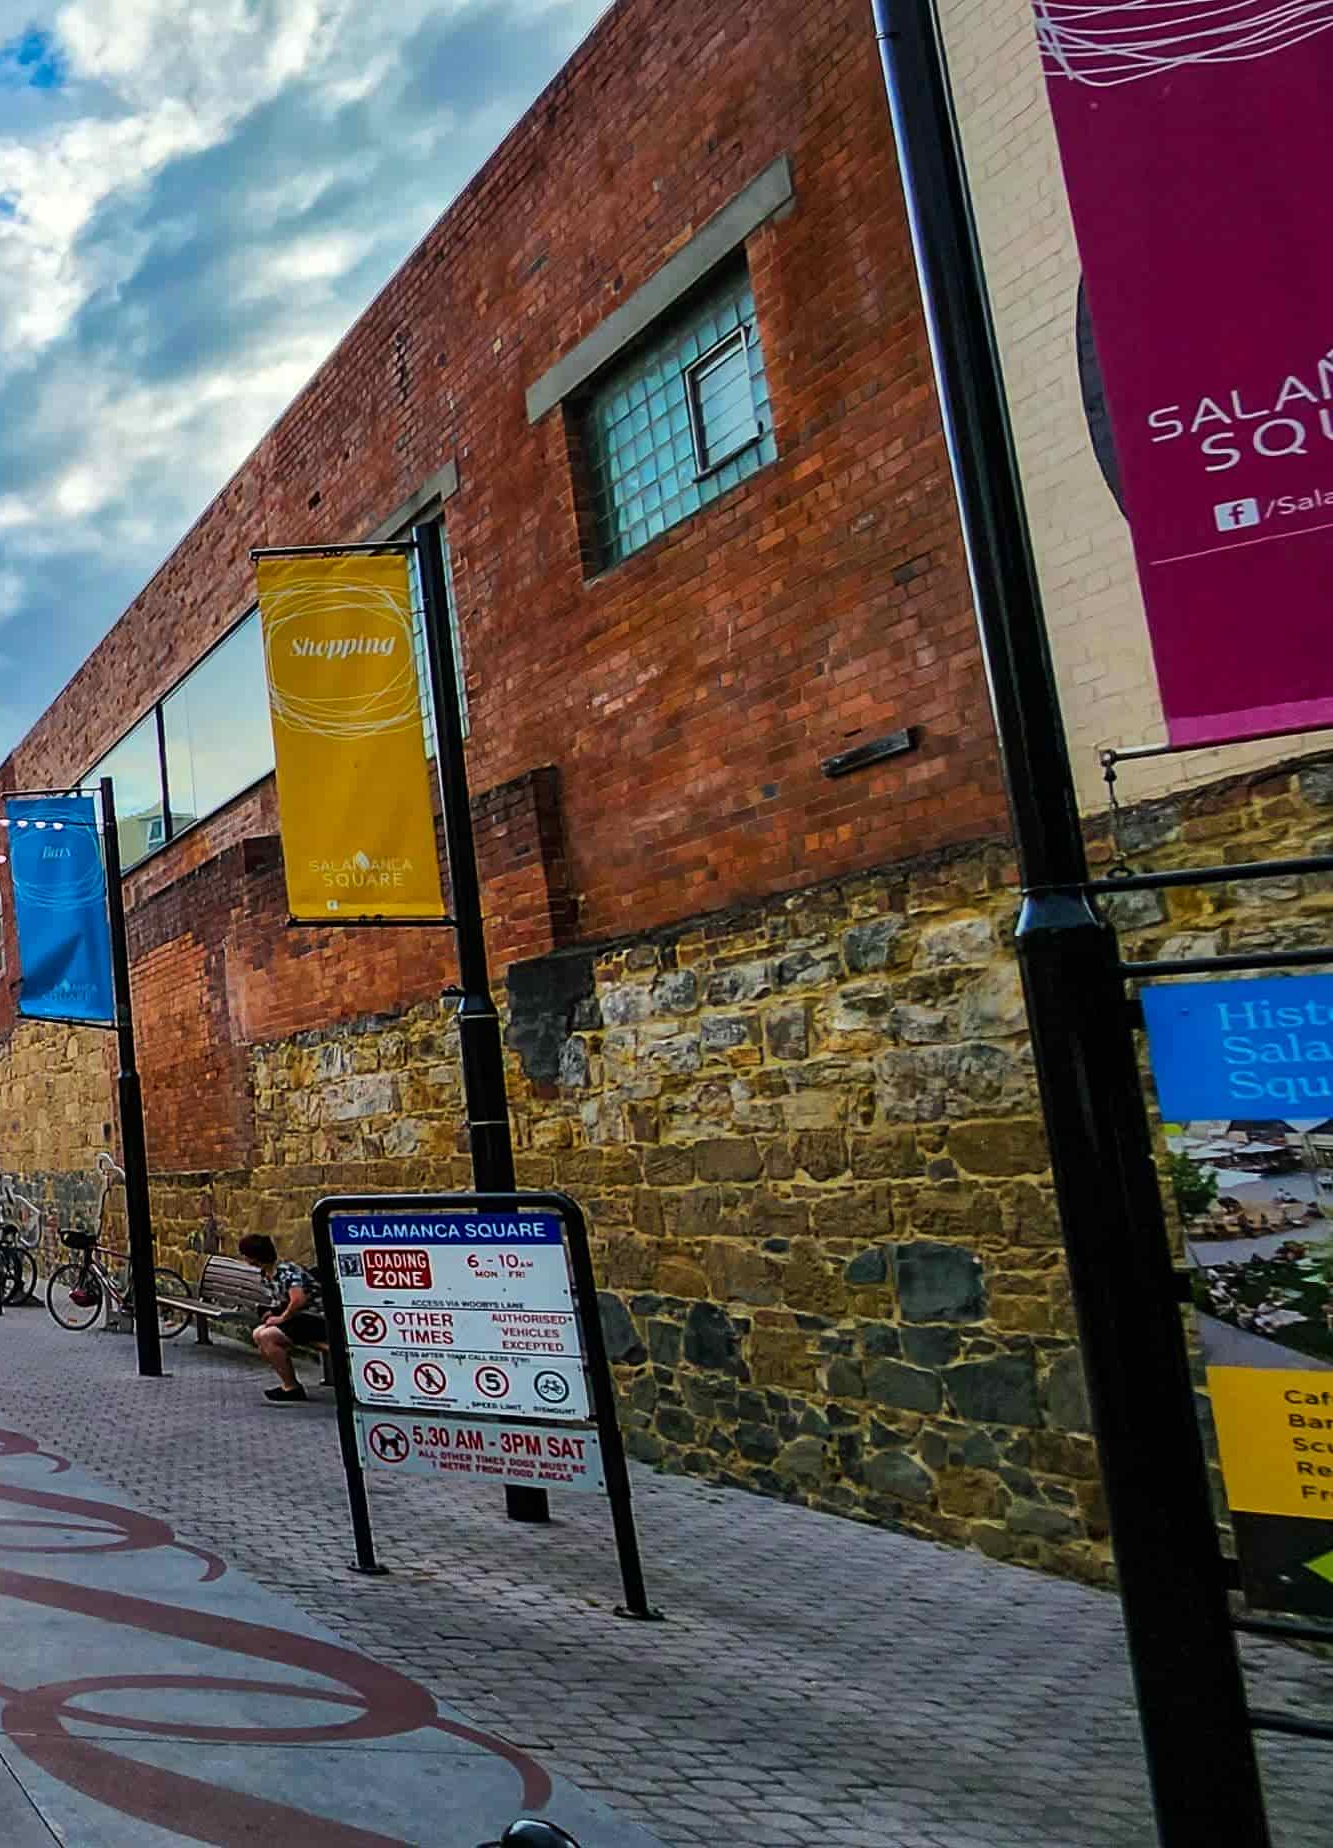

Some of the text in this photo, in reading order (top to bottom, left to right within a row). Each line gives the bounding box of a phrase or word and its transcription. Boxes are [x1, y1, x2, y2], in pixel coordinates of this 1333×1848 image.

[290, 633, 395, 660] Shopping
[324, 872, 406, 888] SQUARE
[1214, 999, 1333, 1031] Hist
[1222, 1032, 1333, 1064] Sala
[1229, 1071, 1333, 1104] Squ
[348, 1222, 547, 1239] SALAMANCA SQUARE
[366, 1252, 427, 1269] LOADING
[467, 1254, 479, 1268] 6
[373, 1270, 526, 1287] ZONE MON FRI
[411, 1299, 444, 1307] ACCESS
[393, 1312, 454, 1327] OTHER
[492, 1313, 568, 1325] AUTHORISED
[398, 1329, 454, 1345] TIMES
[501, 1327, 560, 1338] VEHICLES
[501, 1340, 565, 1352] EXCEPTED
[485, 1373, 501, 1391] 5
[471, 1401, 497, 1410] SPEED
[500, 1403, 522, 1411] LIMIT
[413, 1425, 449, 1447] 5.30
[456, 1428, 484, 1450] AM
[500, 1432, 542, 1456] 3PM
[547, 1437, 585, 1460] SAT
[419, 1450, 587, 1474] ALL OTHER TIMES DOGS MUST BE
[439, 1461, 471, 1472] METRE
[476, 1464, 503, 1475] FROM
[507, 1468, 534, 1479] FOOD
[538, 1471, 574, 1482] AREAS
[1301, 1485, 1333, 1501] Fr
